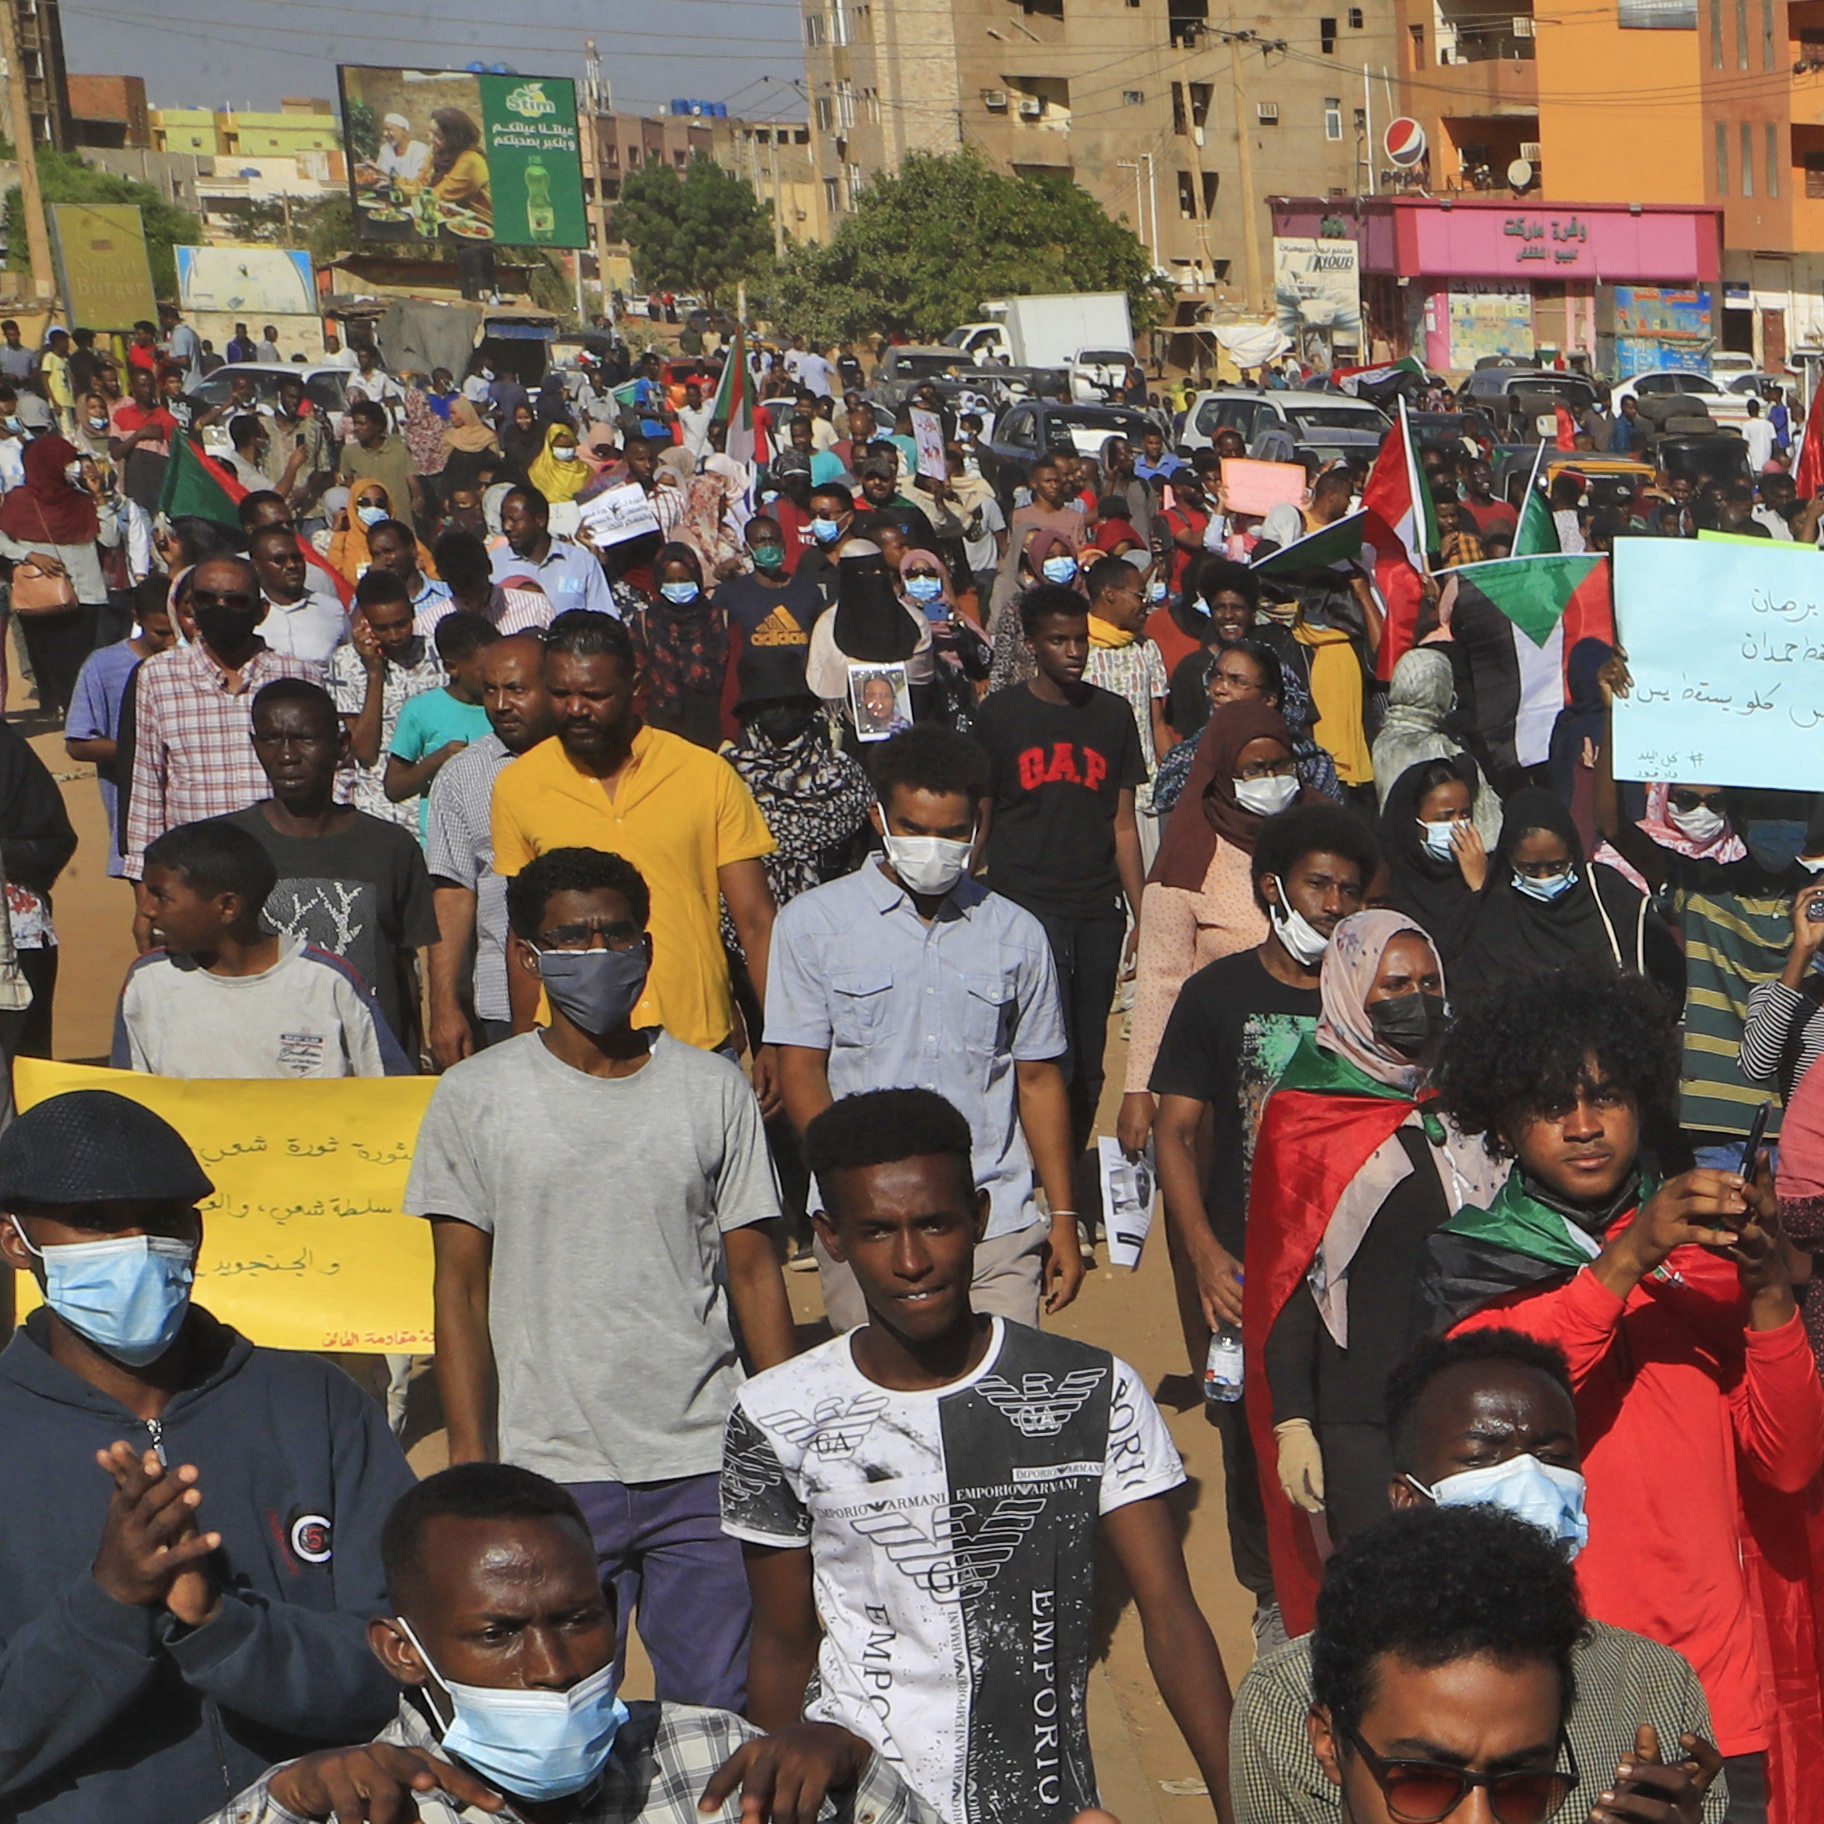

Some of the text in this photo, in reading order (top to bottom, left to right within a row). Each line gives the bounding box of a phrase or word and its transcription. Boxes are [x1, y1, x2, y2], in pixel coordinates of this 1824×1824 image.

[506, 95, 557, 115] Stim
[1503, 215, 1587, 241] وفرة ماركت
[77, 278, 144, 296] Burger
[1752, 588, 1818, 622] برهان
[750, 630, 808, 646] adidas
[1741, 633, 1798, 663] حمدان
[1018, 742, 1107, 791] GAP
[286, 1136, 339, 1157] ثورة
[888, 1492, 947, 1511] ARMANI
[956, 1484, 1019, 1501] EMPORIO
[1031, 1589, 1062, 1806] EMPORIO
